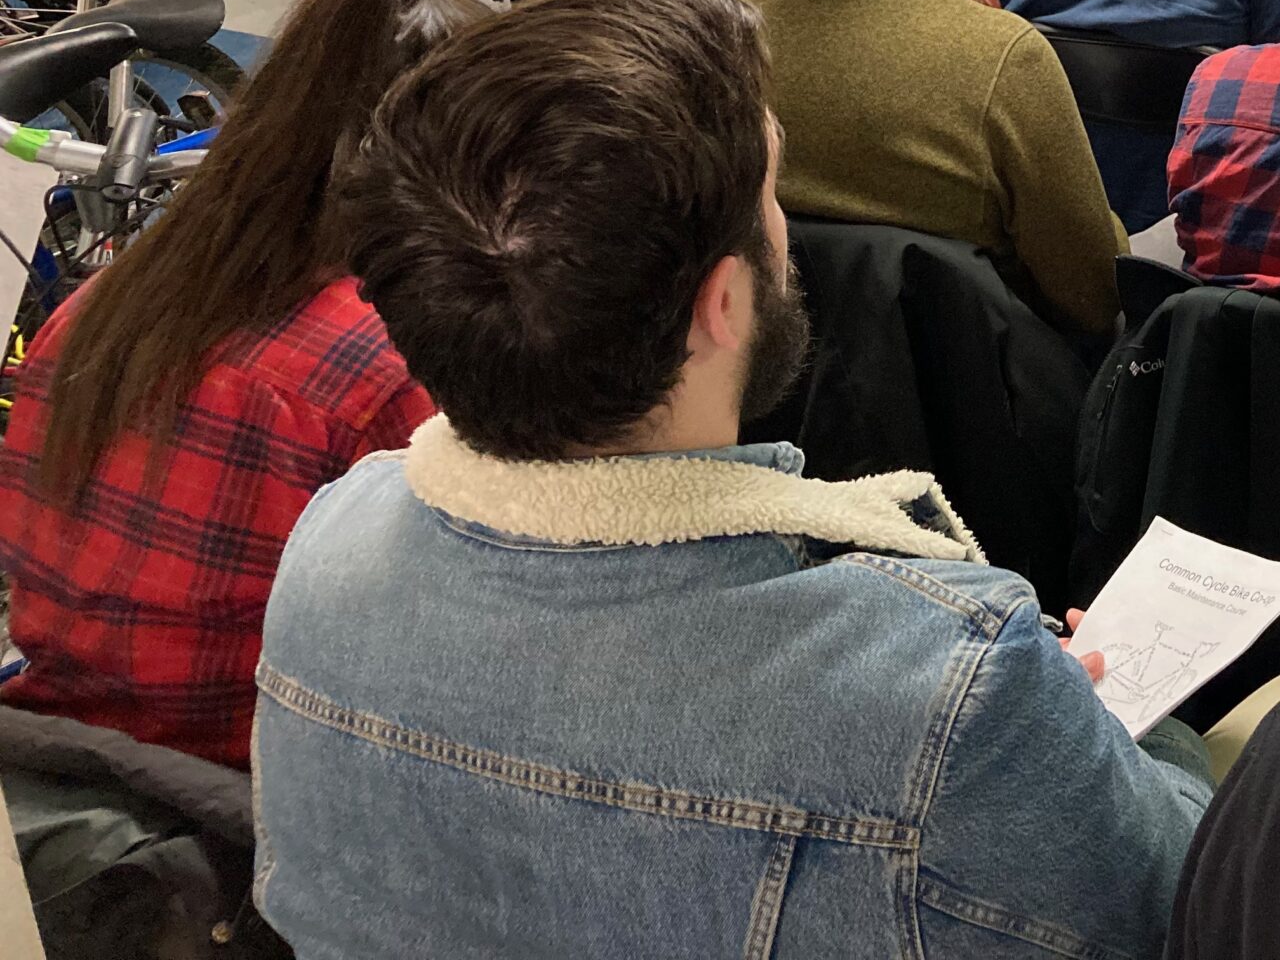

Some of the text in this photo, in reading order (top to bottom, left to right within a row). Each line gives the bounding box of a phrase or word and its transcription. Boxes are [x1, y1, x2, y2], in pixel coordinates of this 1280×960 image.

[1159, 558, 1276, 607] Common Cycle Bike Co-op
